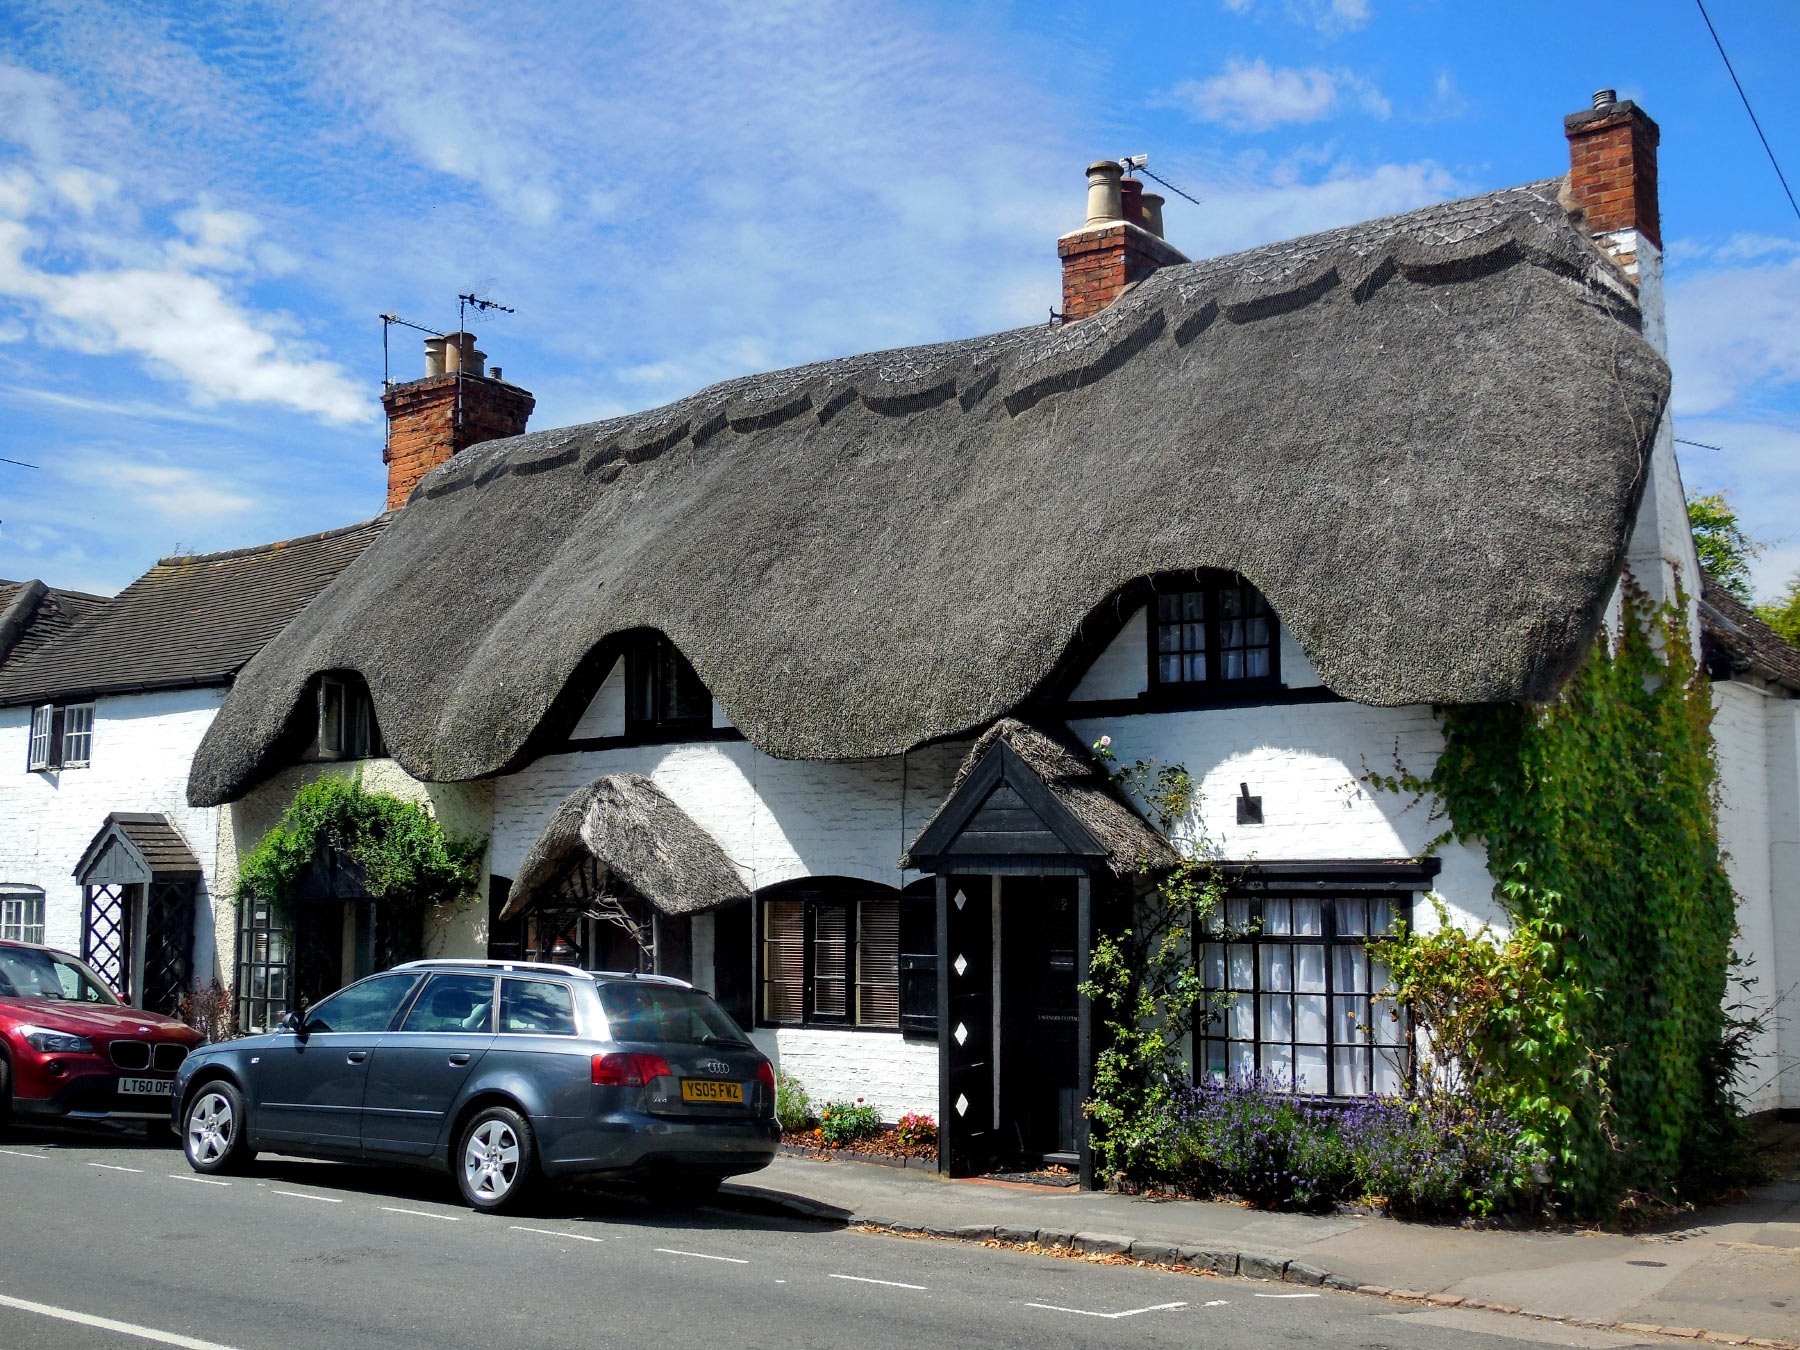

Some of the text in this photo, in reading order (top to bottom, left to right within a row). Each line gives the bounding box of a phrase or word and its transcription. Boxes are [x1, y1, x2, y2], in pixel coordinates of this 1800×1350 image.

[123, 1079, 153, 1093] LT60
[687, 1082, 739, 1099] YS05 FWZ
